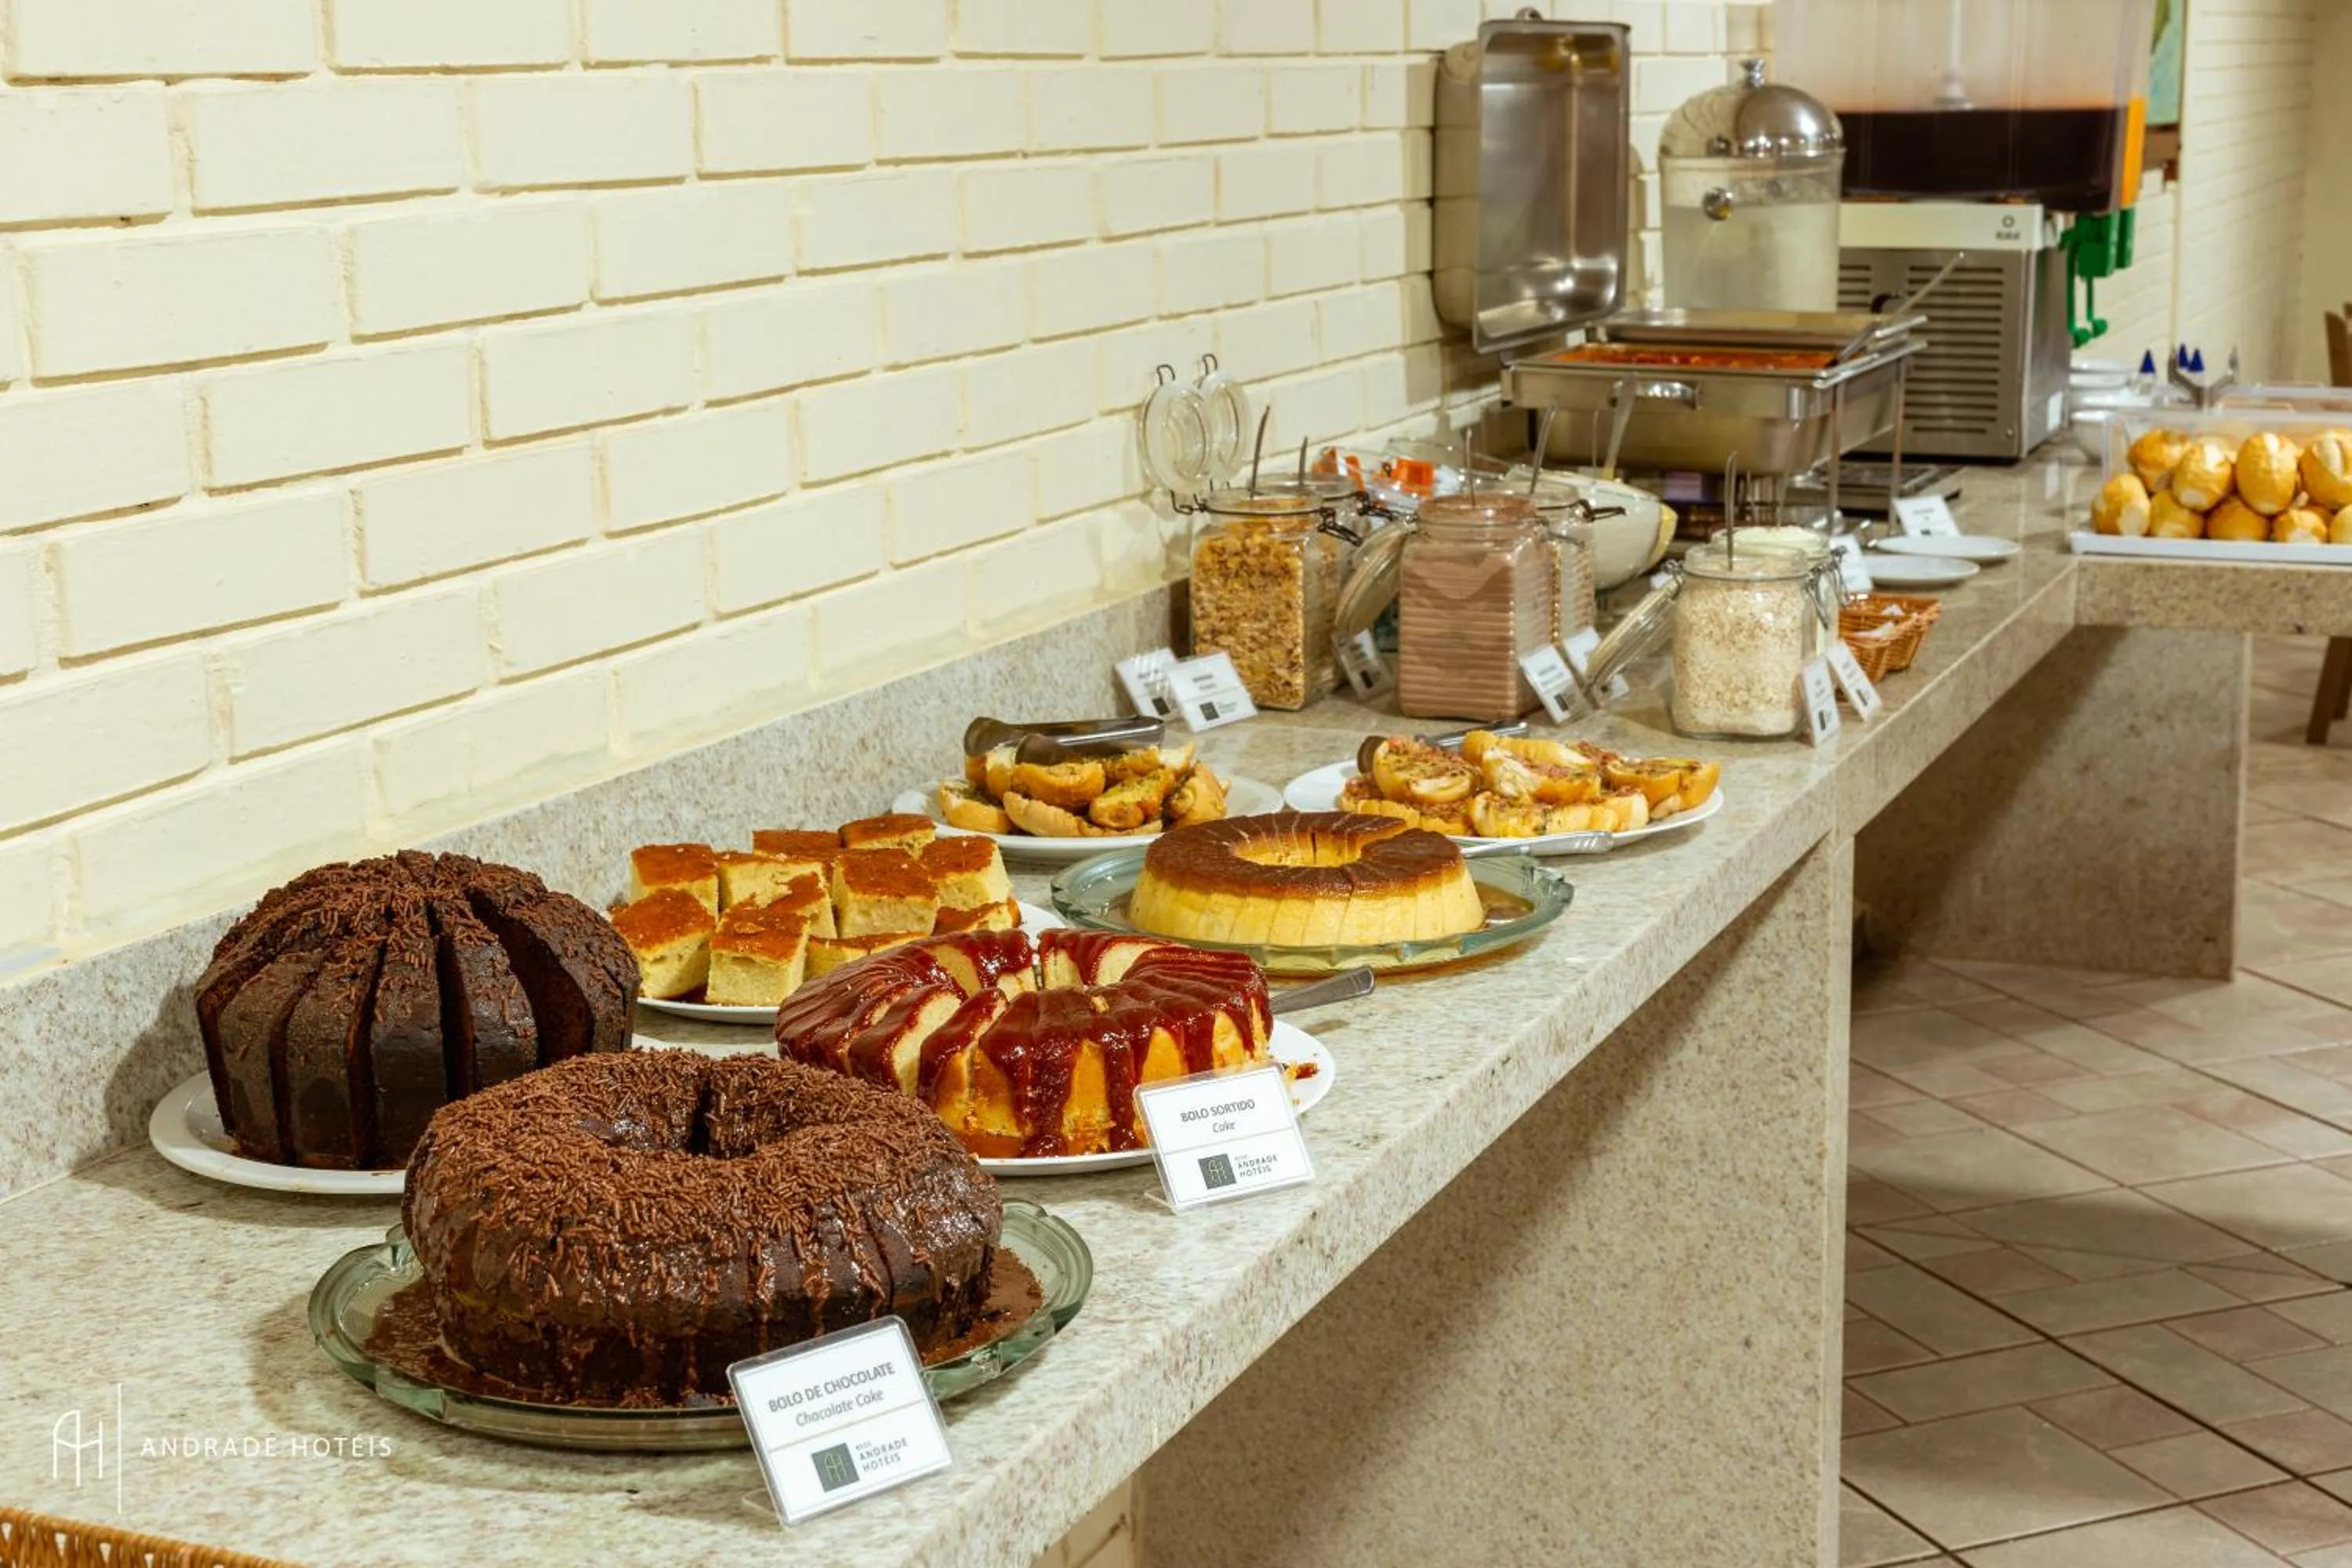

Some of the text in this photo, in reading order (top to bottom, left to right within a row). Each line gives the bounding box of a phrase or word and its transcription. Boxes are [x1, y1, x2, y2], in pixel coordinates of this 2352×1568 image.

[1180, 1098, 1255, 1122] BOLO SORTIDO
[1212, 1120, 1236, 1133] Cake
[768, 1362, 895, 1412] BOLO DE CHOCOLATE
[796, 1388, 884, 1427] Chocolate Cake
[858, 1437, 908, 1461] ANDRADE
